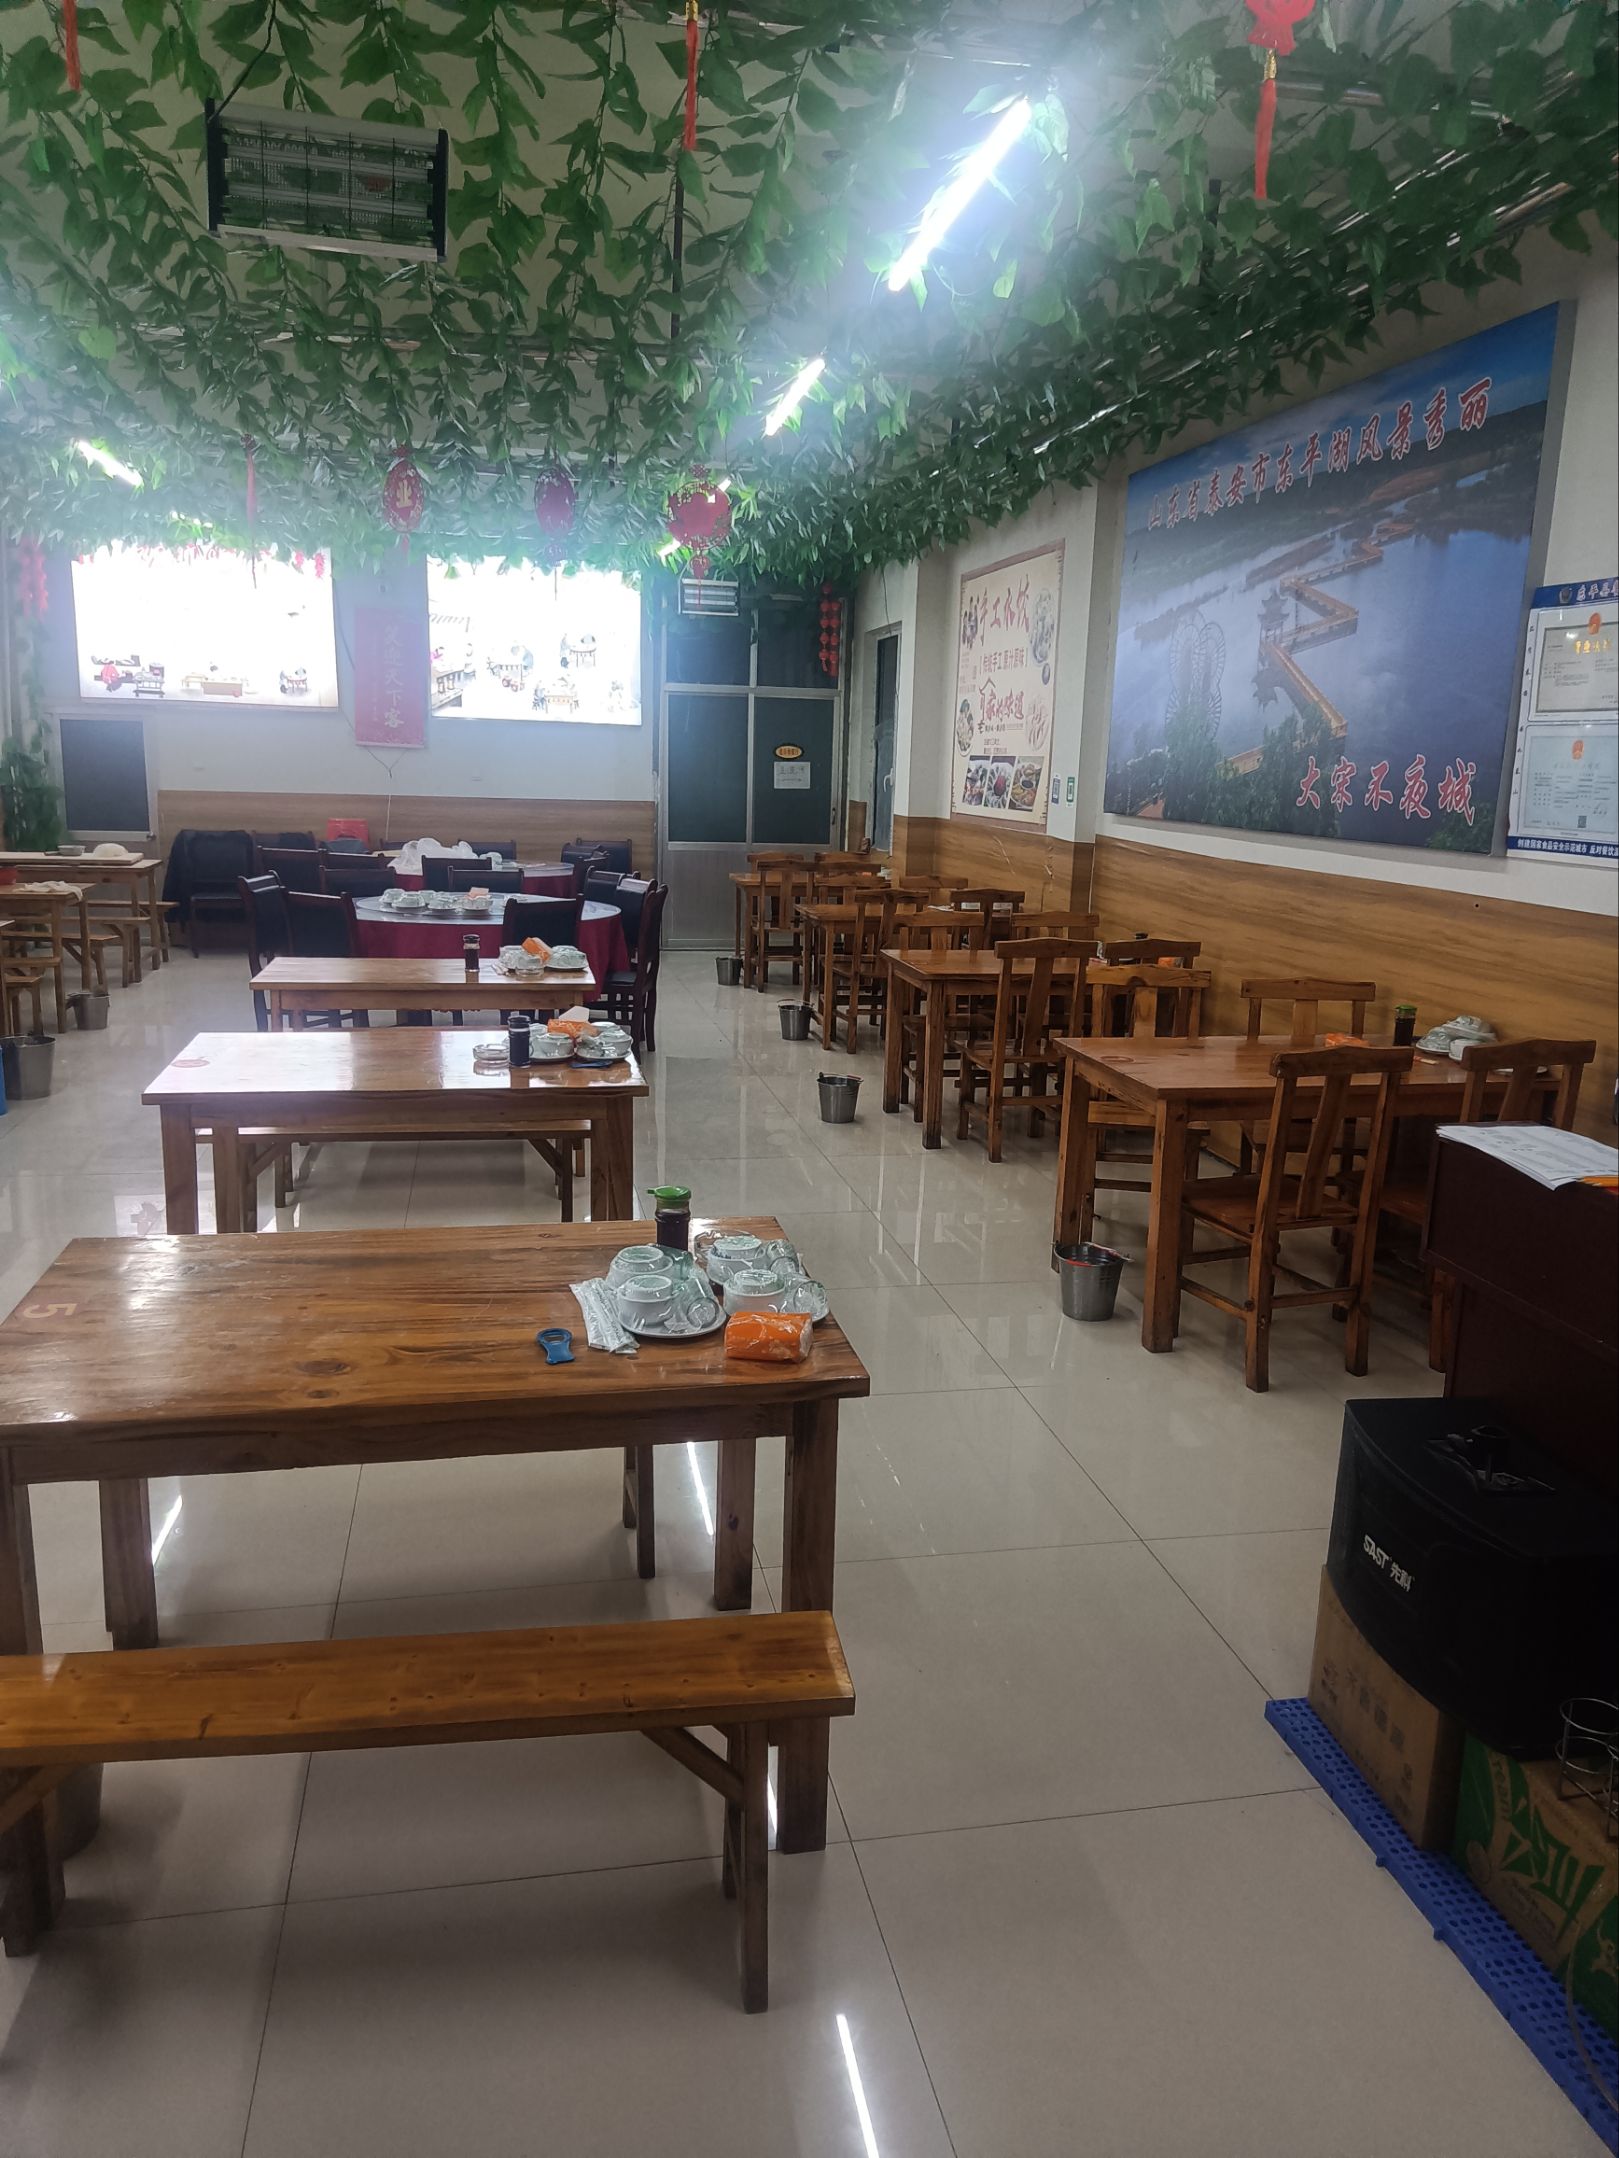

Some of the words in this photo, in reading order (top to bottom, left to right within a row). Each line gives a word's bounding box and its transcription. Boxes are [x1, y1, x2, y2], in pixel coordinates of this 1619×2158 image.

[1147, 376, 1492, 532] 山东省泰安市东平湖风景秀丽
[383, 624, 404, 728] 笑迎天下客
[1295, 755, 1477, 826] 大宋不夜城
[1363, 1534, 1389, 1569] SAST
[1390, 1562, 1412, 1592] 先科
